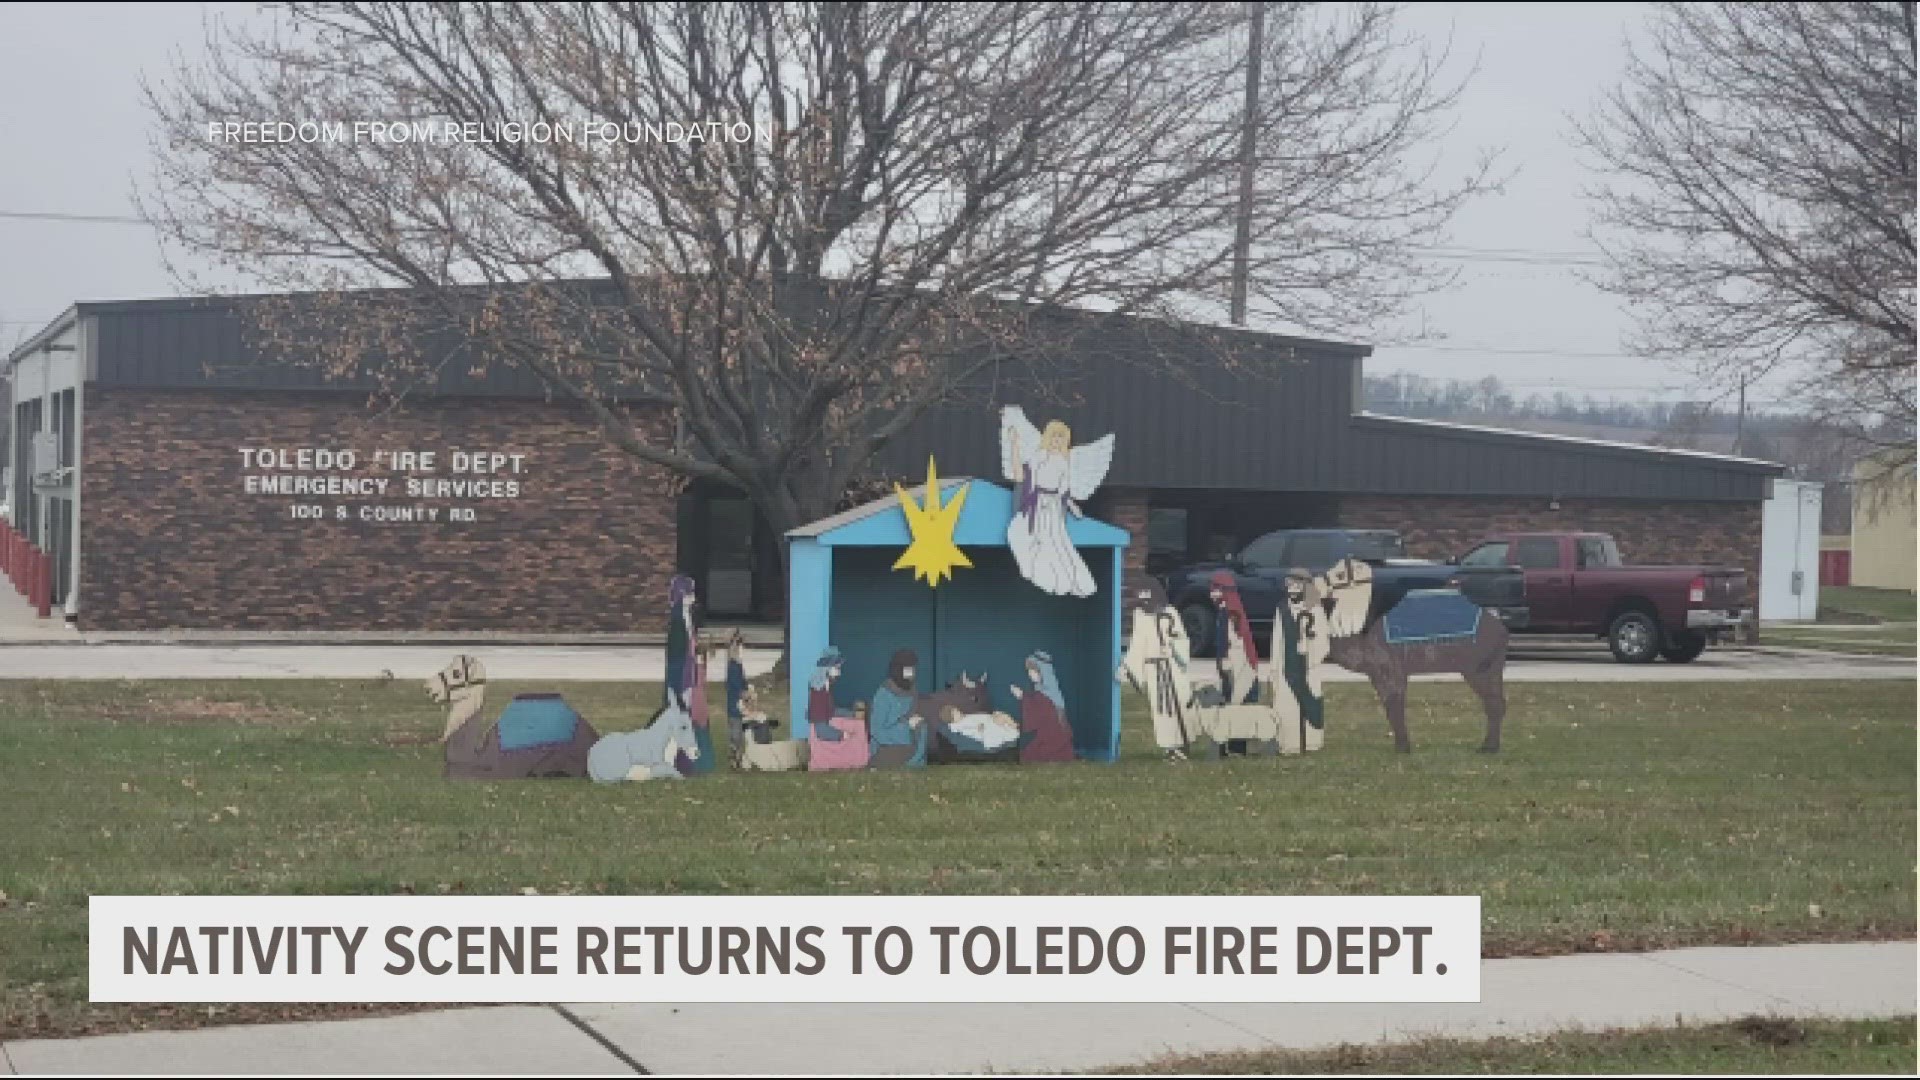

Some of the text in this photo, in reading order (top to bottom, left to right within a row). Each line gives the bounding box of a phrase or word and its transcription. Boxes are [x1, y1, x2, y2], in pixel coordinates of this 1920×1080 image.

[238, 448, 356, 471] TOLEDO
[452, 451, 529, 474] DEPT.
[244, 475, 520, 498] EMERGENCY SERVICES
[289, 505, 323, 519] 100
[360, 505, 439, 521] COUNTY
